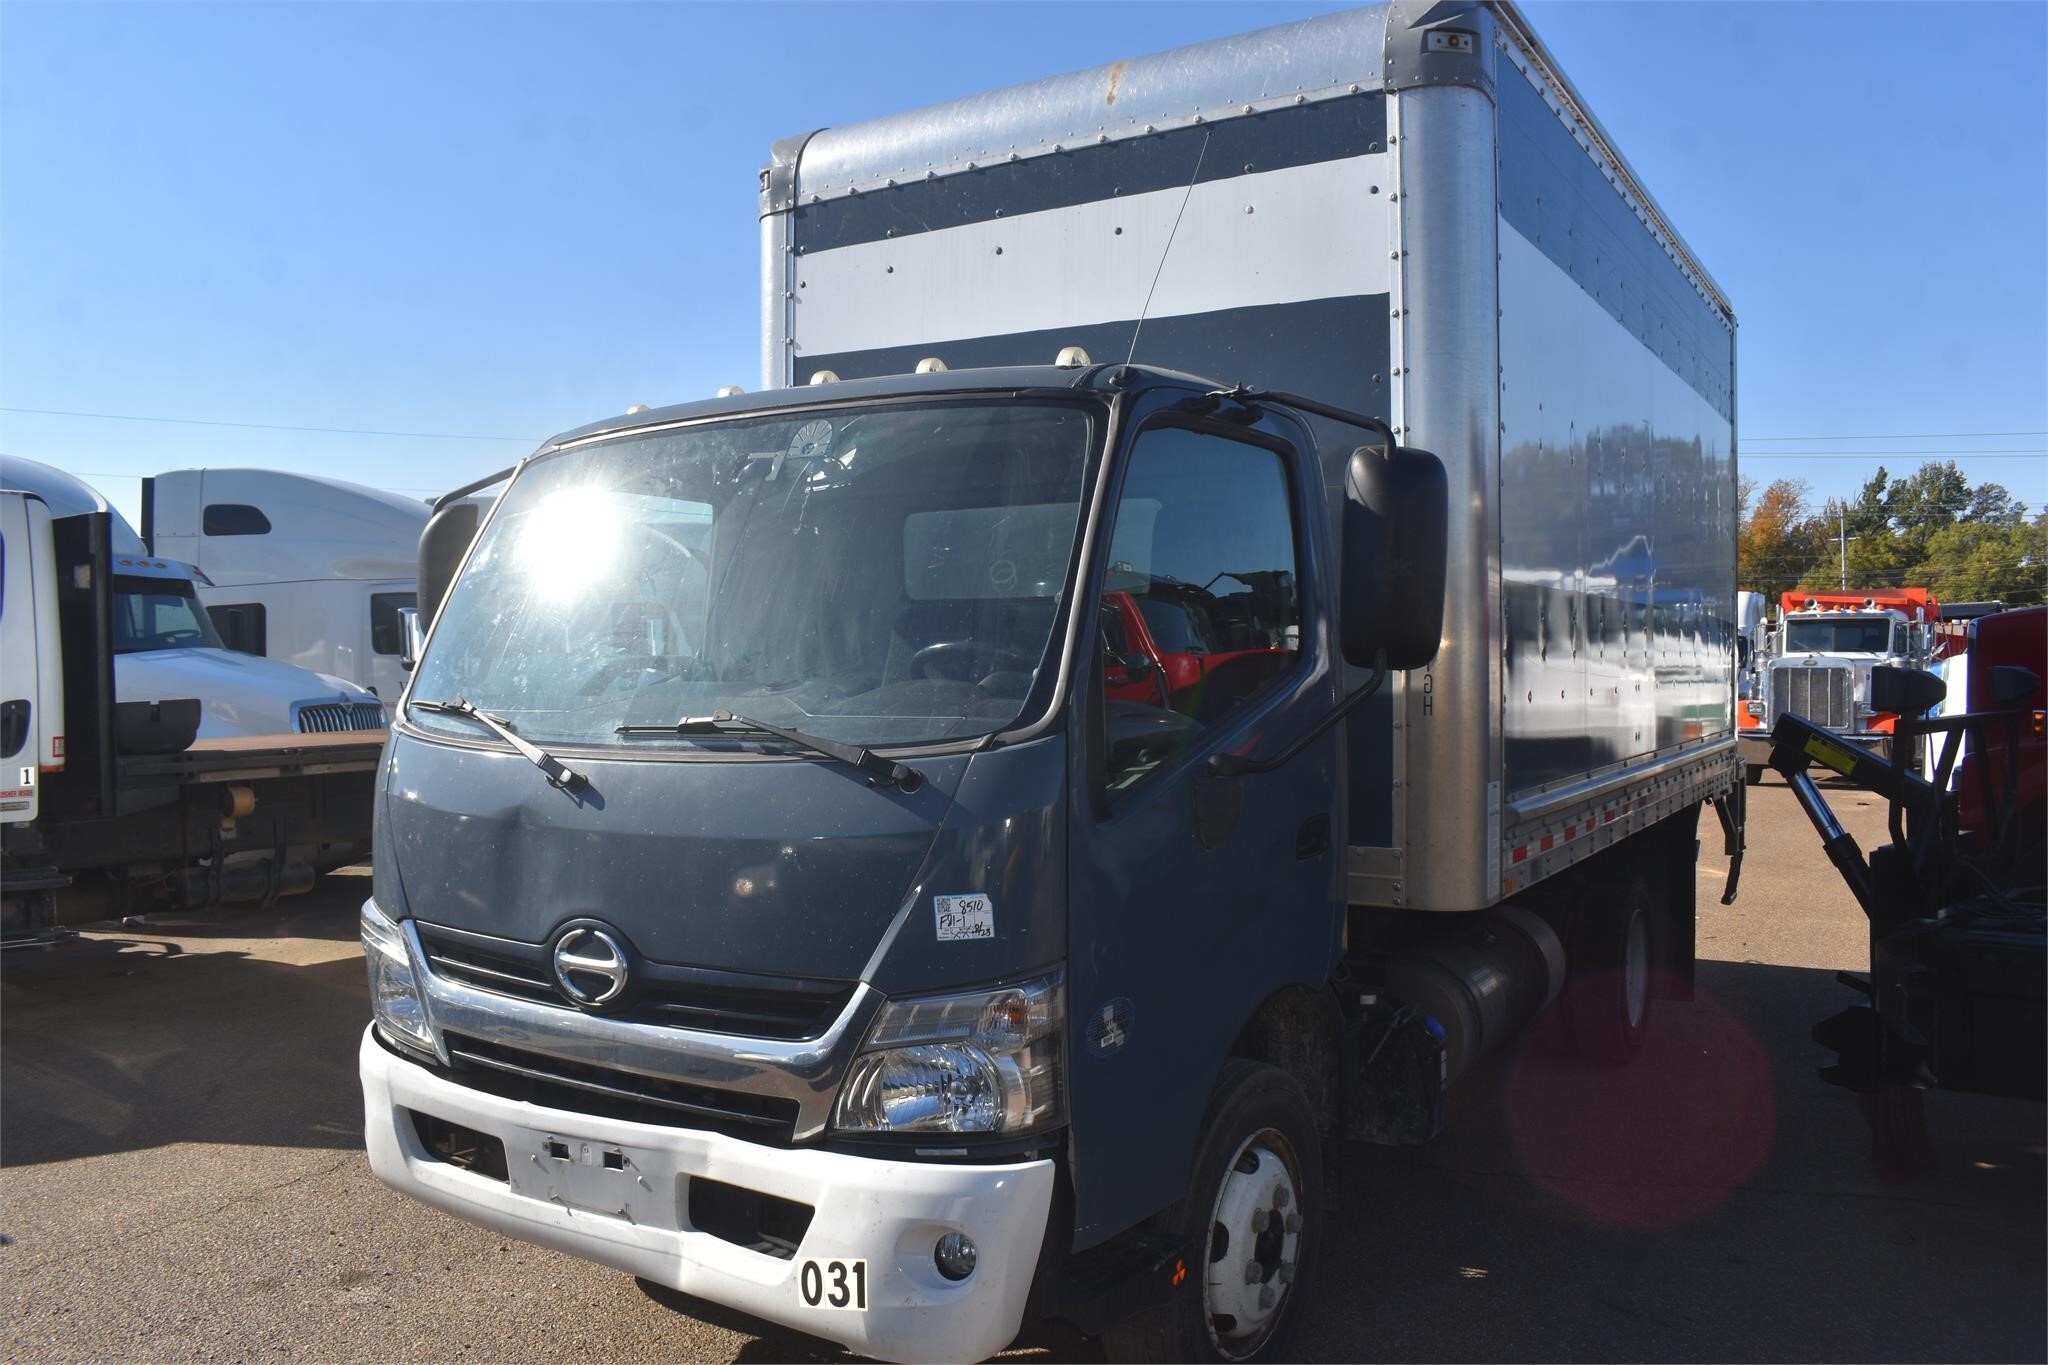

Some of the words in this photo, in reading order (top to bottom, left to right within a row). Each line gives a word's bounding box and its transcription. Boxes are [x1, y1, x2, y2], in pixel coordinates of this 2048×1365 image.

[24, 768, 31, 785] 1
[958, 899, 984, 915] 8510
[800, 1260, 866, 1309] 031
